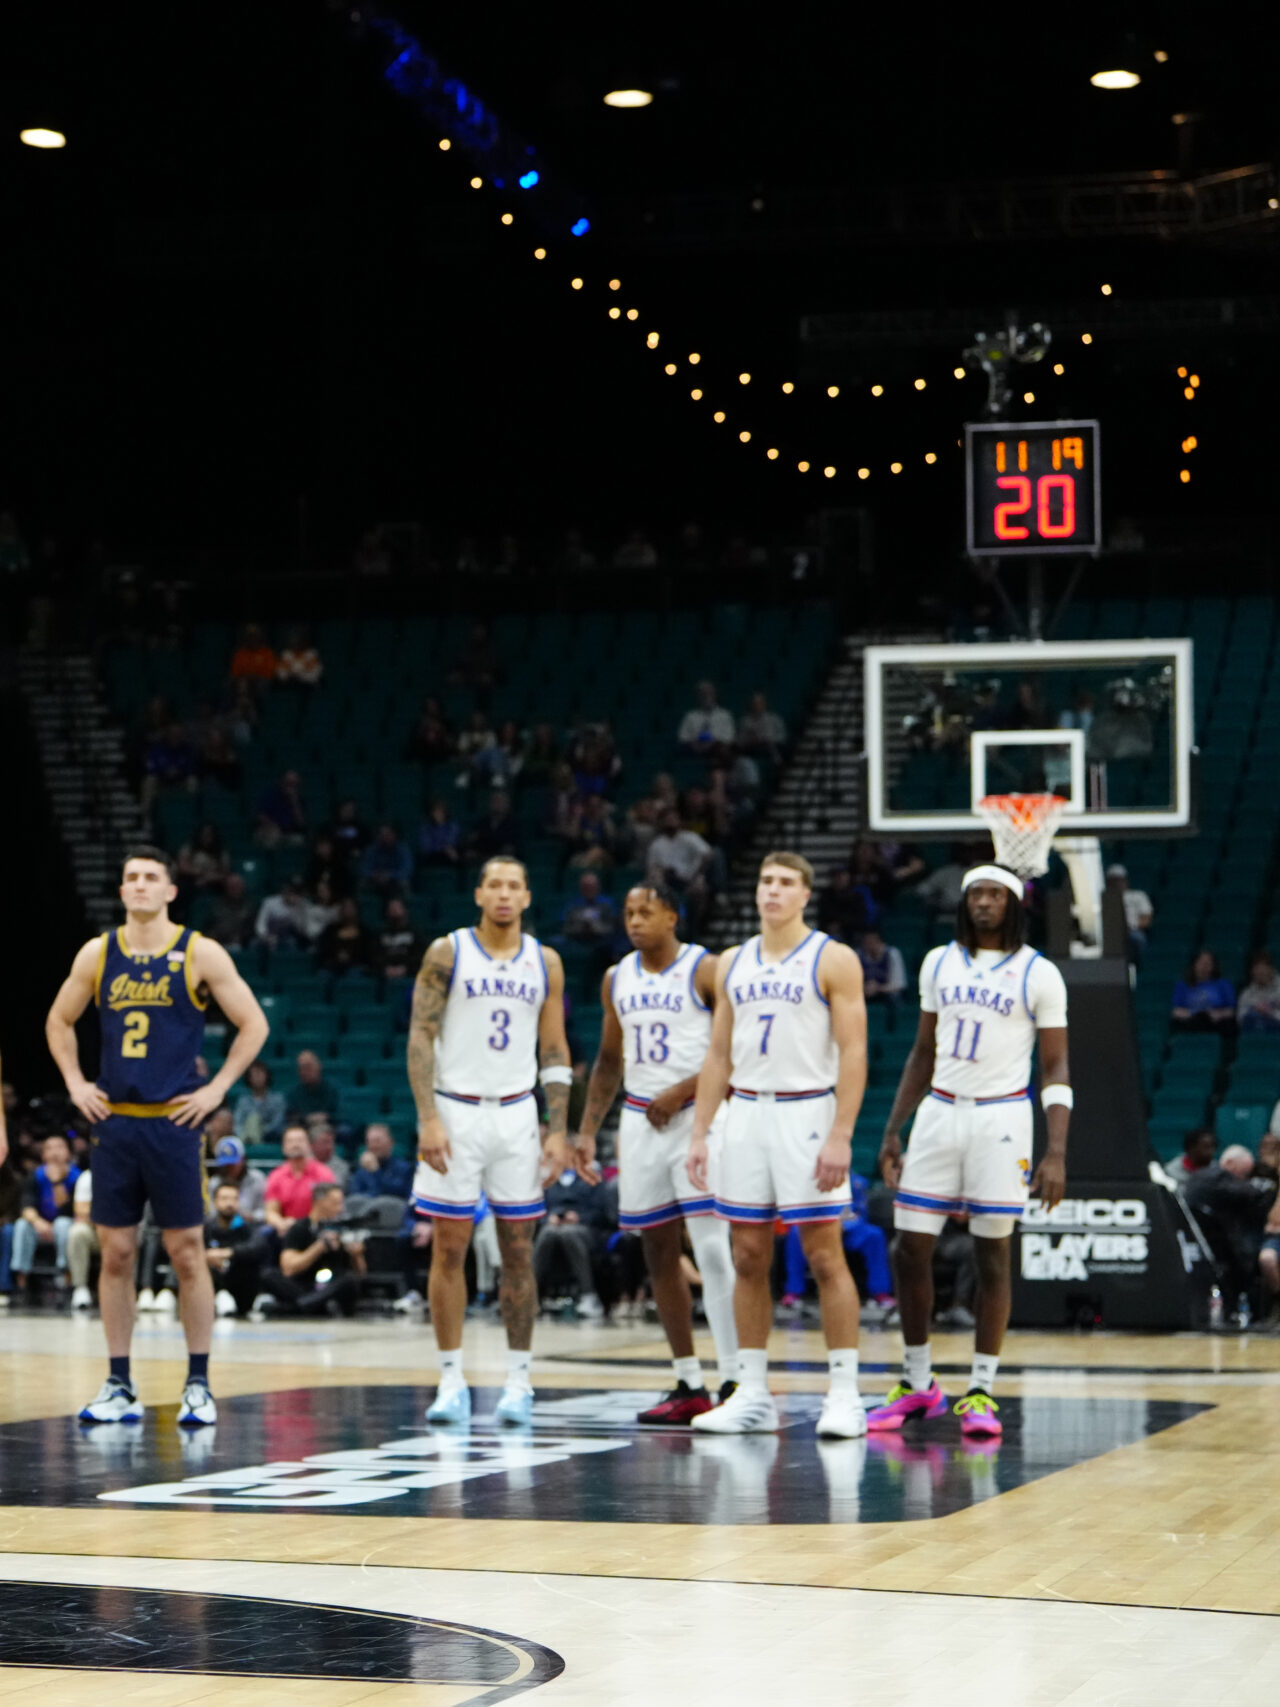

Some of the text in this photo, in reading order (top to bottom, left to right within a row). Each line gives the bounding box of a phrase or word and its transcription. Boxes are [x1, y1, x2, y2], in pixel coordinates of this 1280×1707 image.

[994, 474, 1076, 541] 20
[108, 971, 174, 1009] Irish
[464, 978, 538, 1005] KANSAS
[619, 990, 684, 1015] KANSAS
[733, 981, 804, 1006] KANSAS
[938, 985, 1015, 1017] KANSAS
[121, 1010, 150, 1058] 2
[488, 1009, 510, 1051] 3
[633, 1022, 670, 1065] 13
[757, 1014, 776, 1056] 7
[951, 1016, 983, 1064] 11
[1022, 1199, 1147, 1227] GEICO
[1021, 1233, 1149, 1262] PLAYERS
